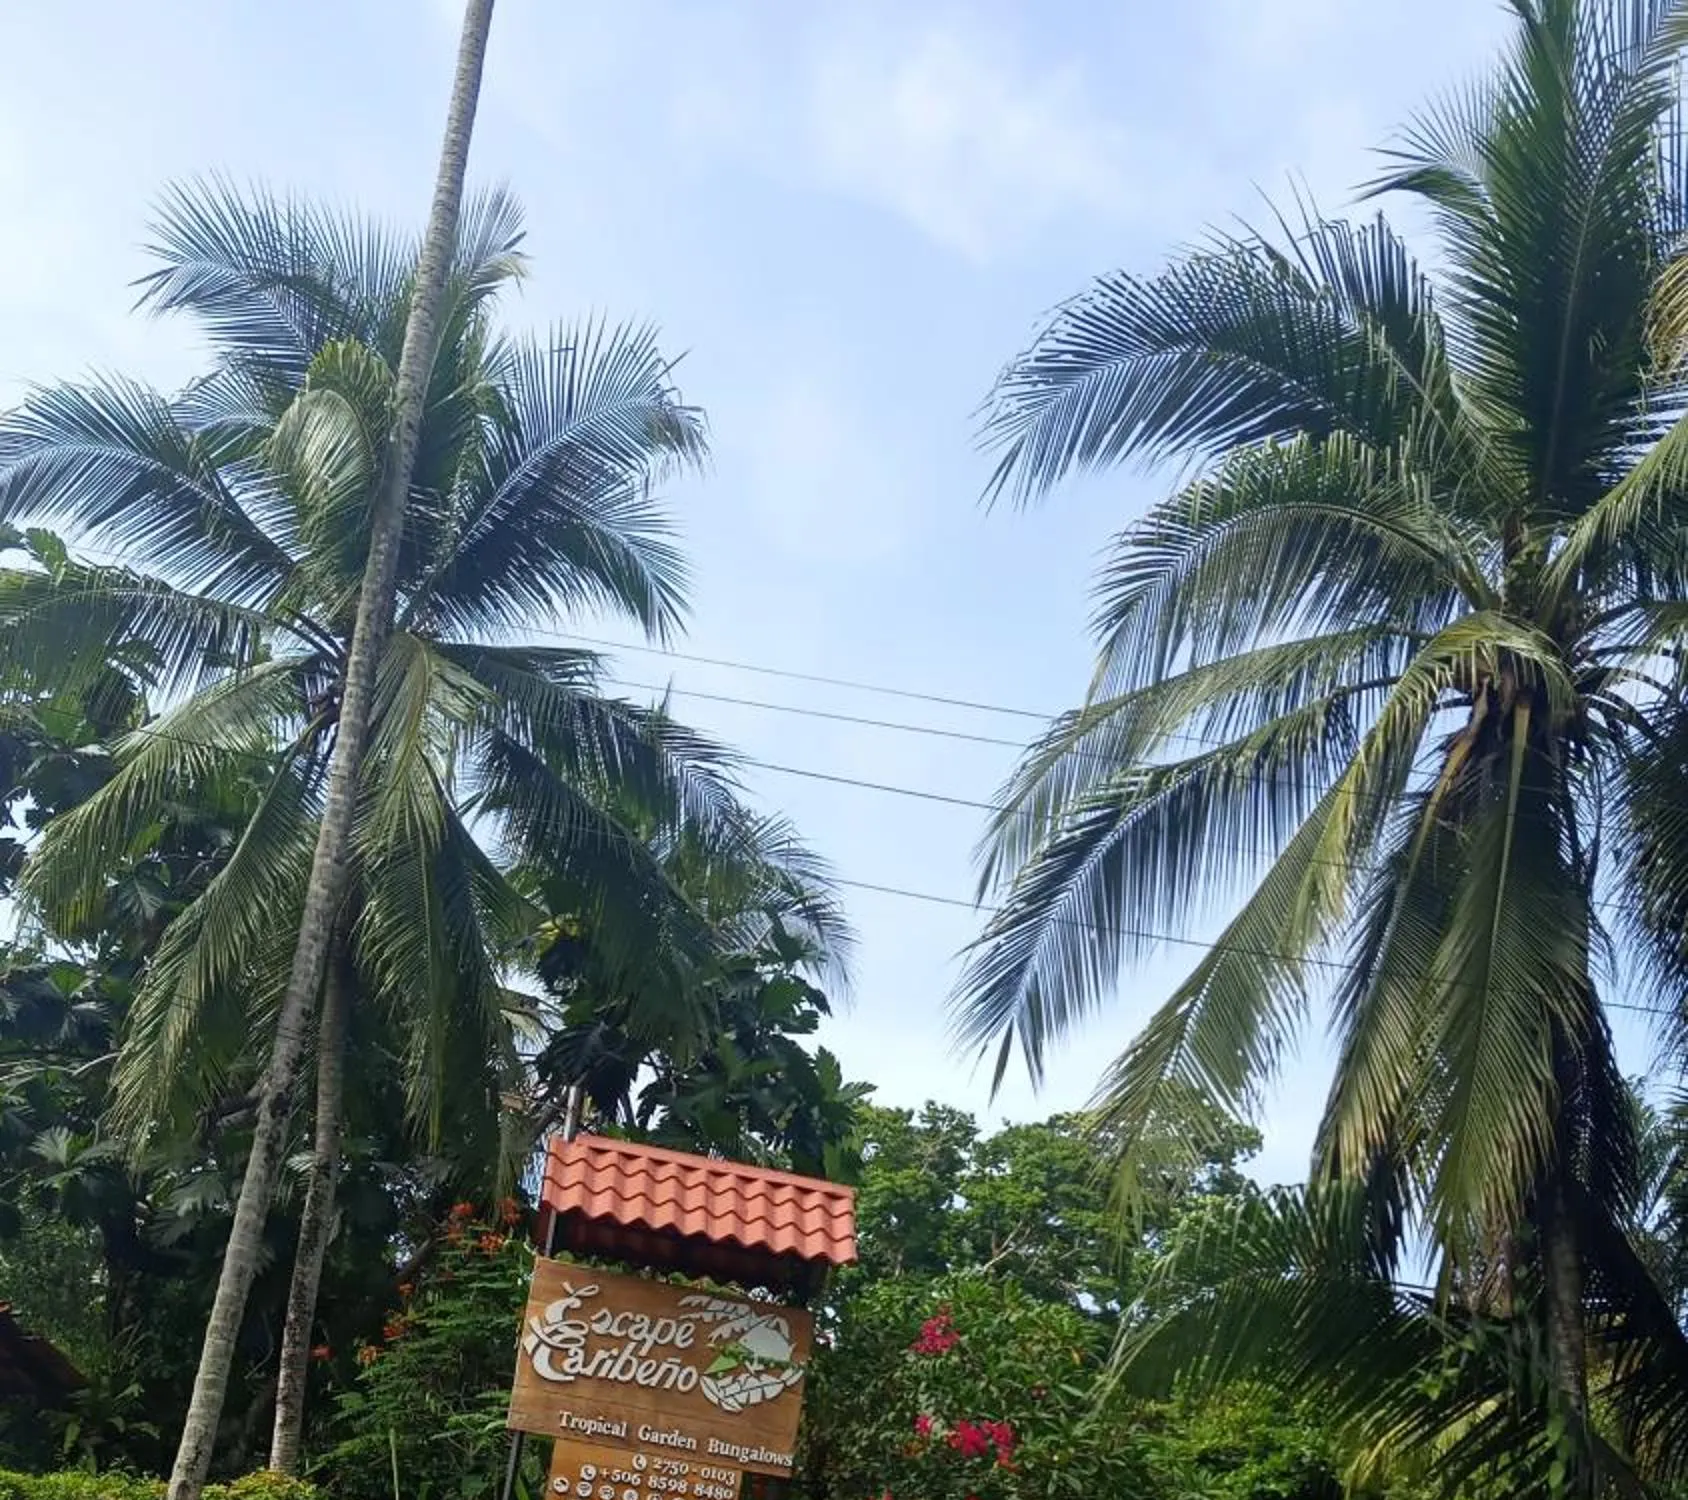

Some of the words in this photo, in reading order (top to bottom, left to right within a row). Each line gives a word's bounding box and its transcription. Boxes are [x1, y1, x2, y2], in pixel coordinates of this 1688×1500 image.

[544, 1282, 696, 1354] Escape
[522, 1316, 699, 1393] Caribeño
[559, 1411, 628, 1438] Tropical
[638, 1425, 697, 1450] Garden
[708, 1438, 794, 1468] Bungalows
[600, 1467, 641, 1486] +506
[648, 1475, 688, 1493] 8598
[693, 1484, 734, 1500] 8480
[652, 1457, 689, 1476] 2750
[700, 1468, 736, 1486] 0103
